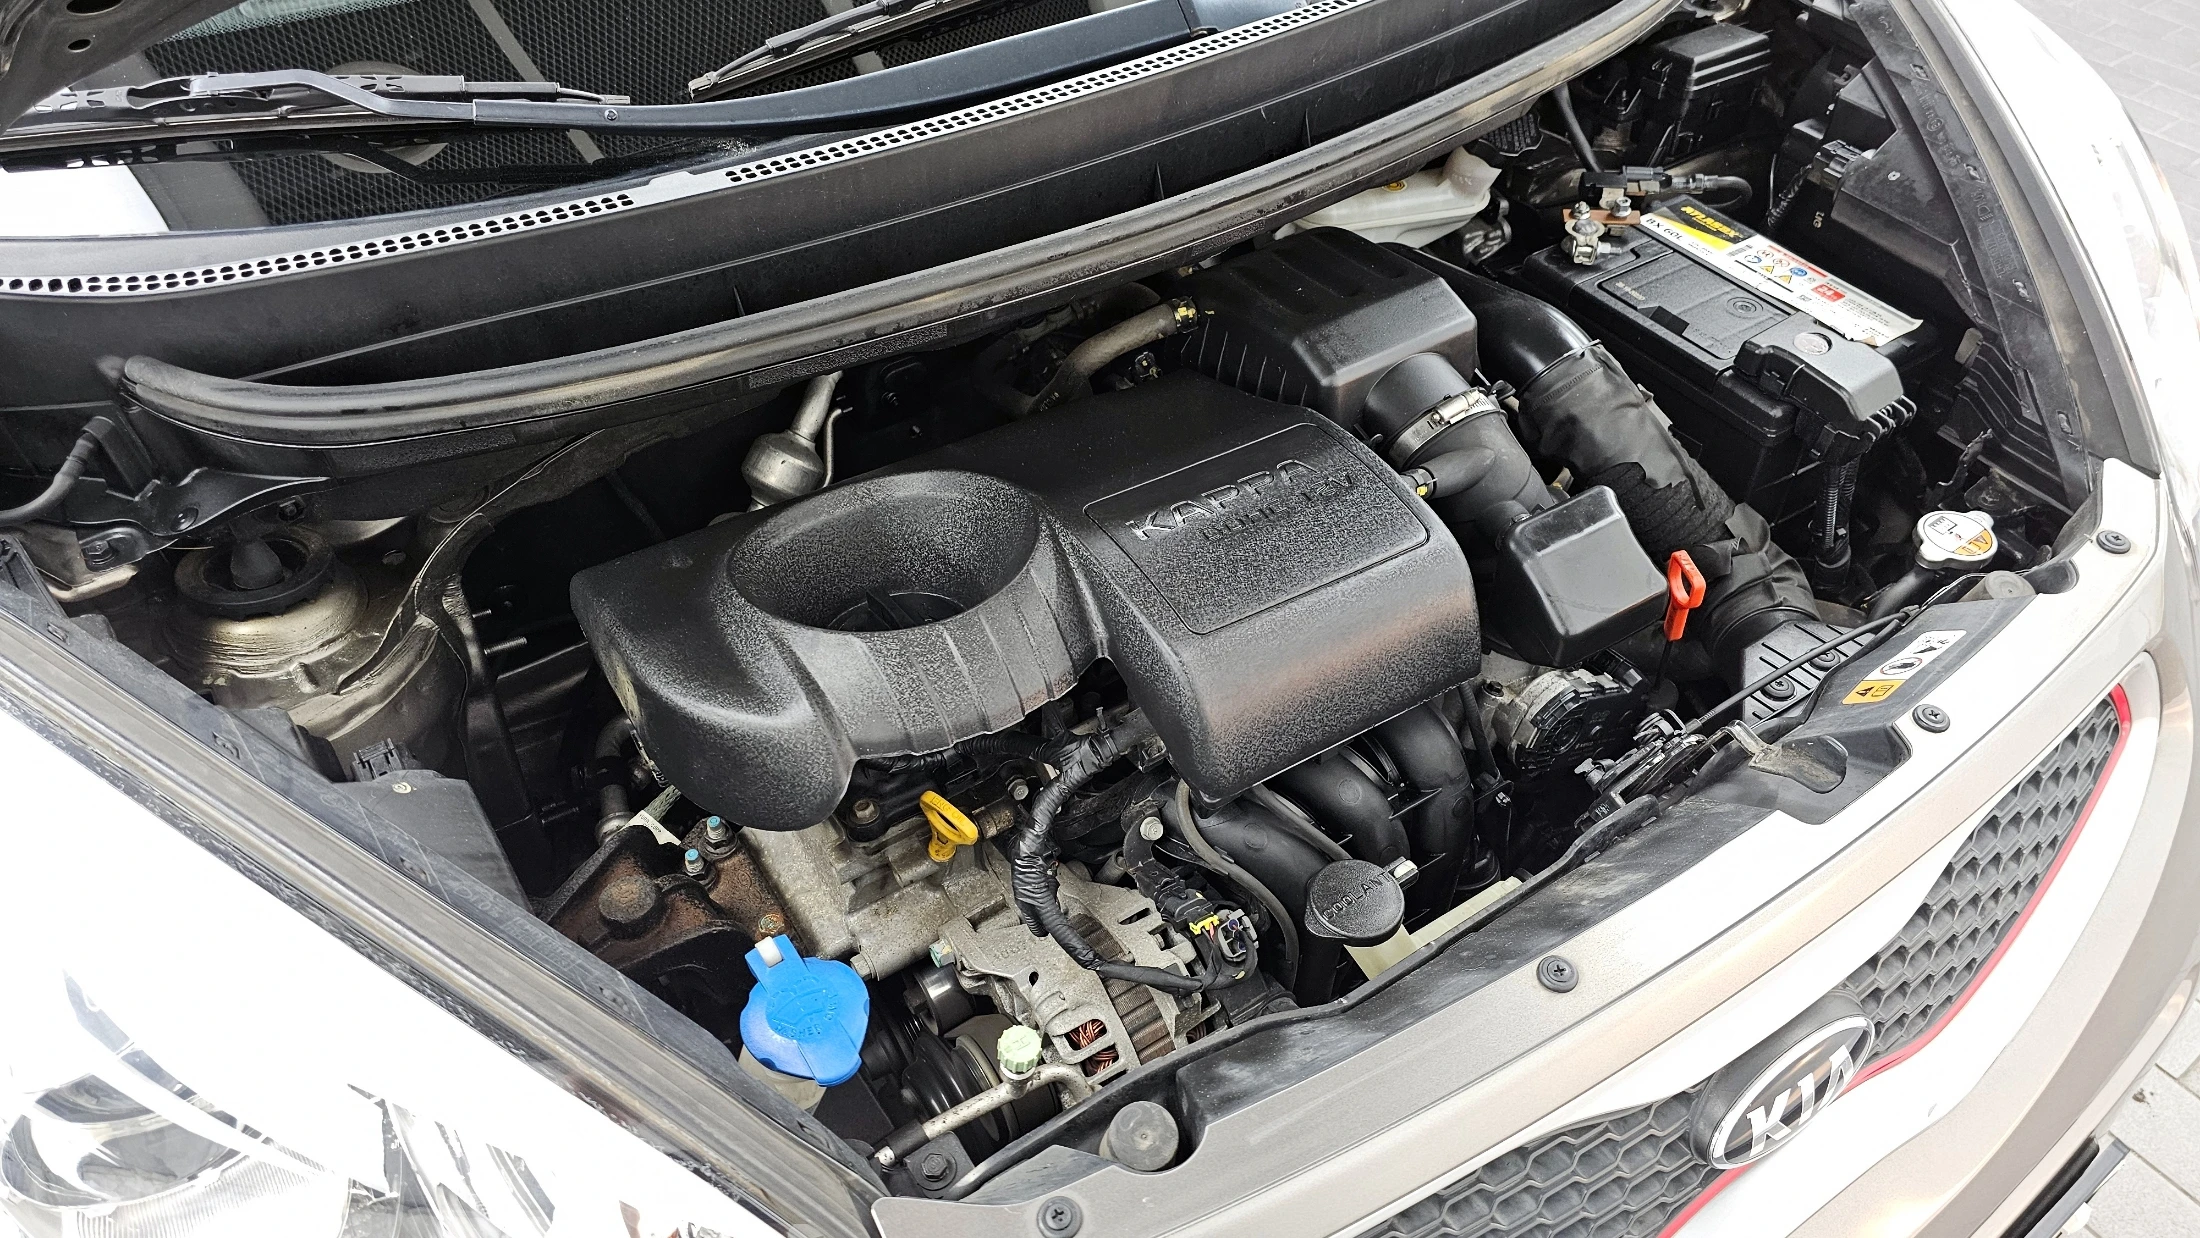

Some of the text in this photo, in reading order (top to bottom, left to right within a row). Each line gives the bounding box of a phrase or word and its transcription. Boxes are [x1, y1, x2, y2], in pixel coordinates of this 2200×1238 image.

[1680, 205, 1740, 238] ATLASBX
[1125, 459, 1321, 541] KAPPA
[929, 795, 966, 827] ENG OIL
[1322, 871, 1393, 920] COOLANT
[774, 1023, 822, 1040] WASHER
[1746, 1044, 1854, 1157] KIA
